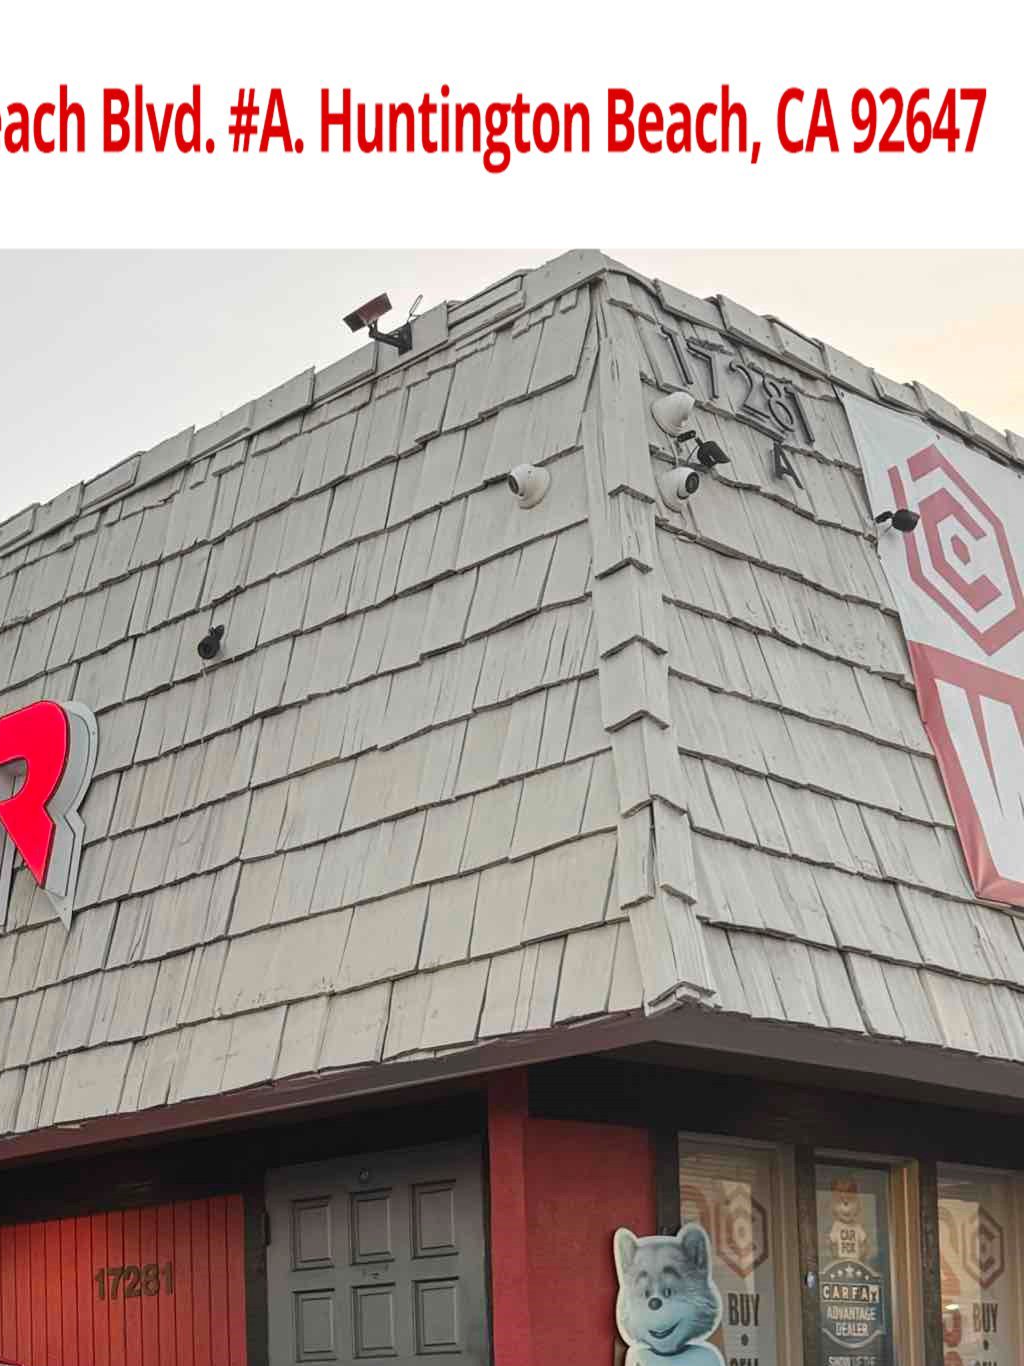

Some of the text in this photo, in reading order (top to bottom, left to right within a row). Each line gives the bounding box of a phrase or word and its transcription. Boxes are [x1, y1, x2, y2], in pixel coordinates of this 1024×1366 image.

[660, 326, 816, 448] 17281
[770, 440, 804, 490] A
[95, 1261, 174, 1300] 17281
[727, 1293, 760, 1327] BUY
[827, 1306, 876, 1321] ADVANTAGE
[973, 1303, 998, 1333] BUY
[836, 1323, 869, 1337] DEALER
